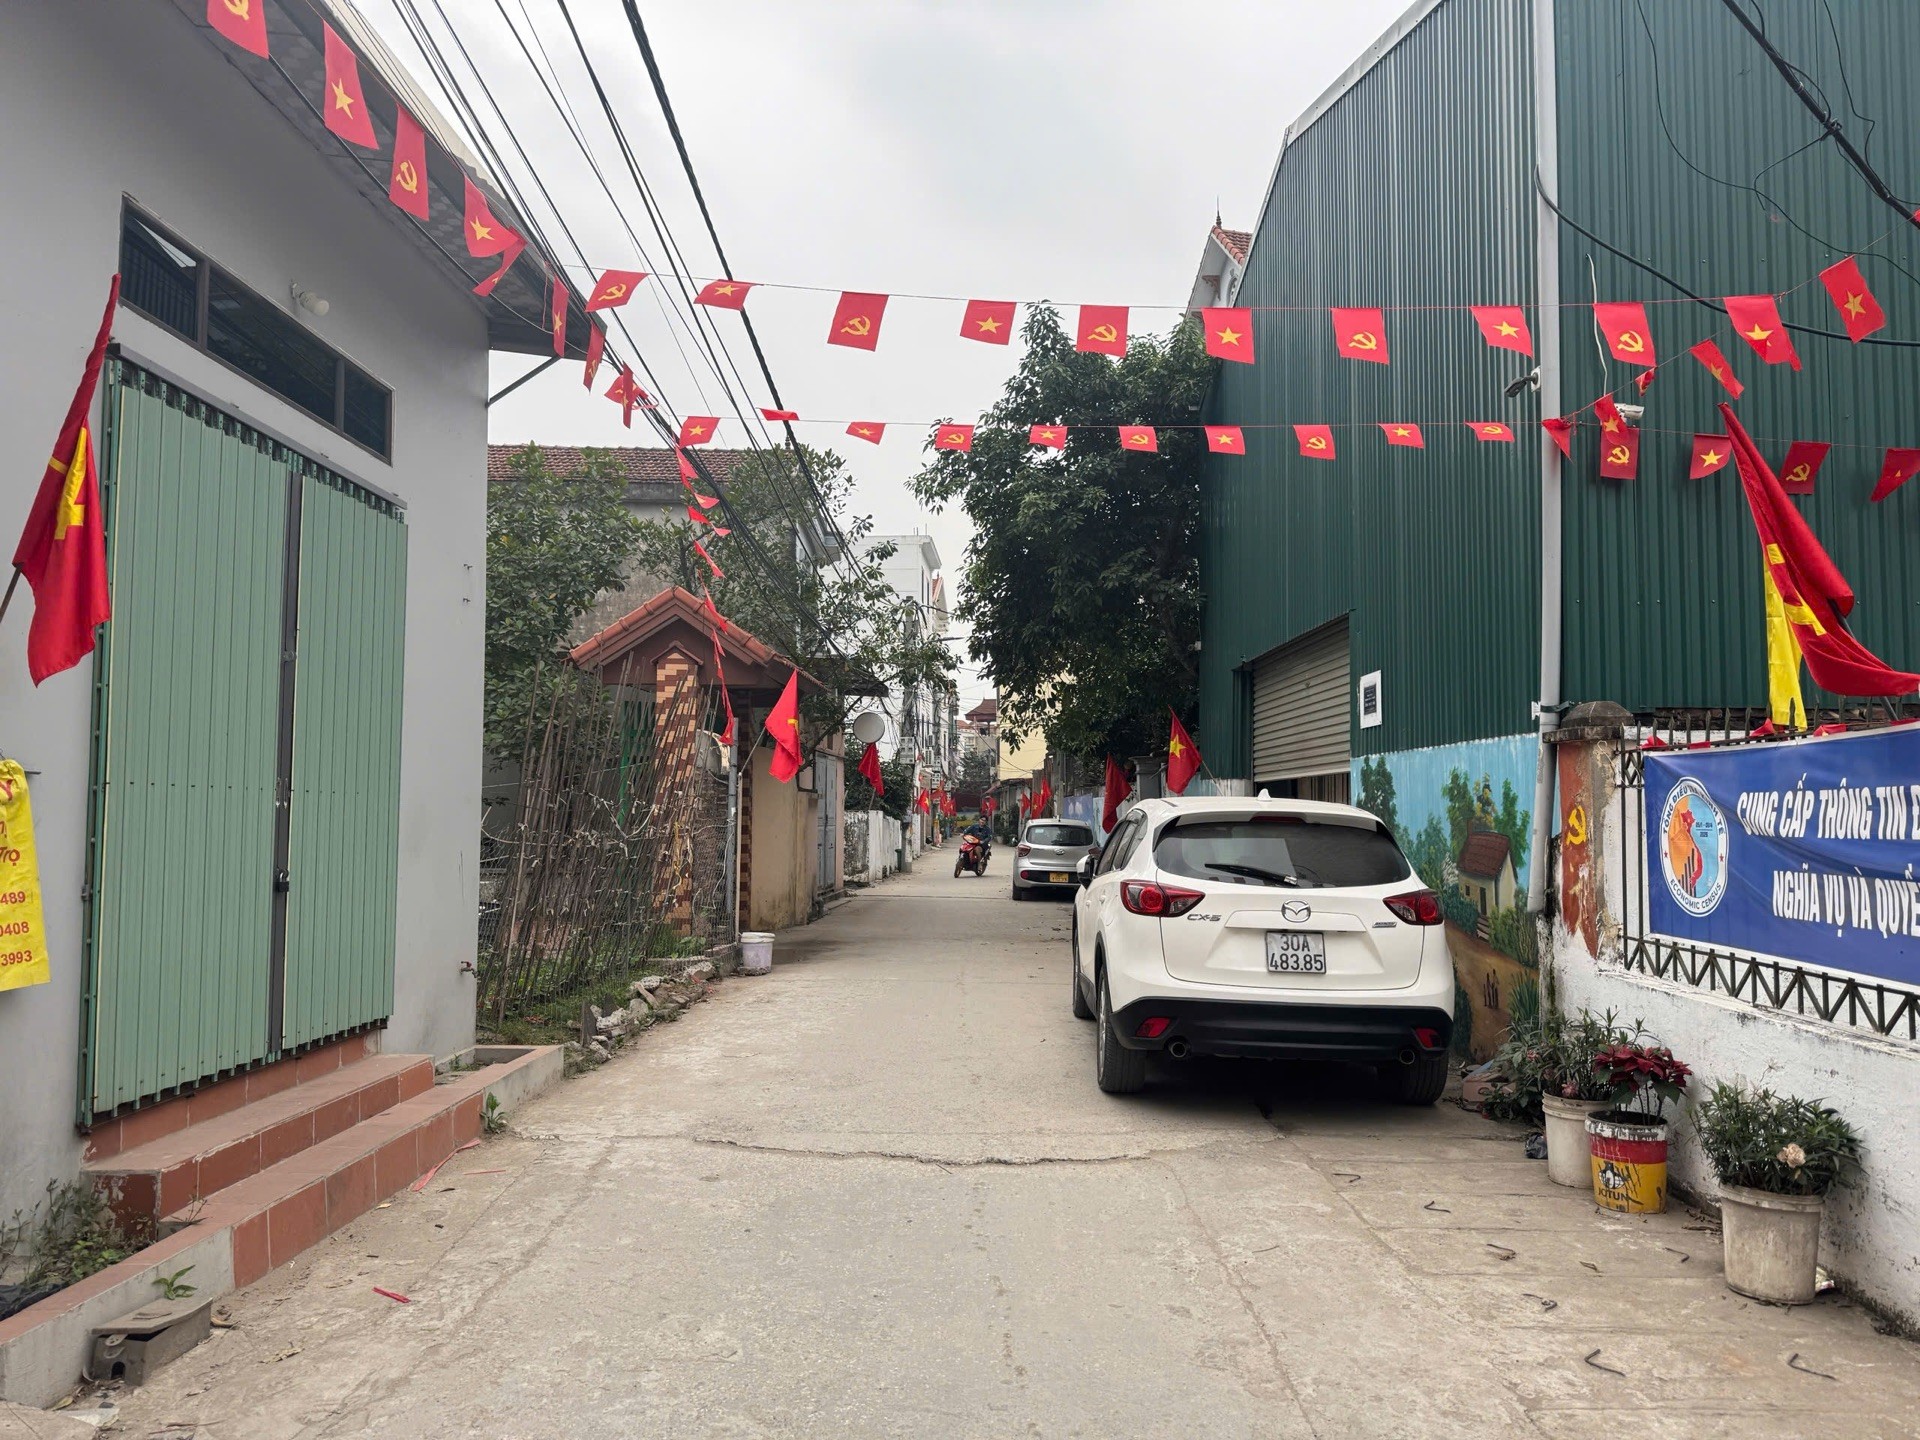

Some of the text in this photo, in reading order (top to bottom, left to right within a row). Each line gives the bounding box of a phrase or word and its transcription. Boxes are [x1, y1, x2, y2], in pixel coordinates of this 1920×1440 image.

[1737, 791, 1779, 837] CUNG
[1779, 773, 1815, 838] CẤP
[1817, 778, 1873, 840] THÔNG
[1875, 786, 1907, 840] TIN
[1670, 878, 1722, 910] ECONOMIC CENSUS
[1772, 862, 1920, 939] NGHĨA VỤ VÀ QUYỀ
[1187, 913, 1222, 922] CX-5
[1280, 933, 1310, 952] 30A
[0, 950, 33, 967] 3993
[1269, 953, 1324, 972] 483.85
